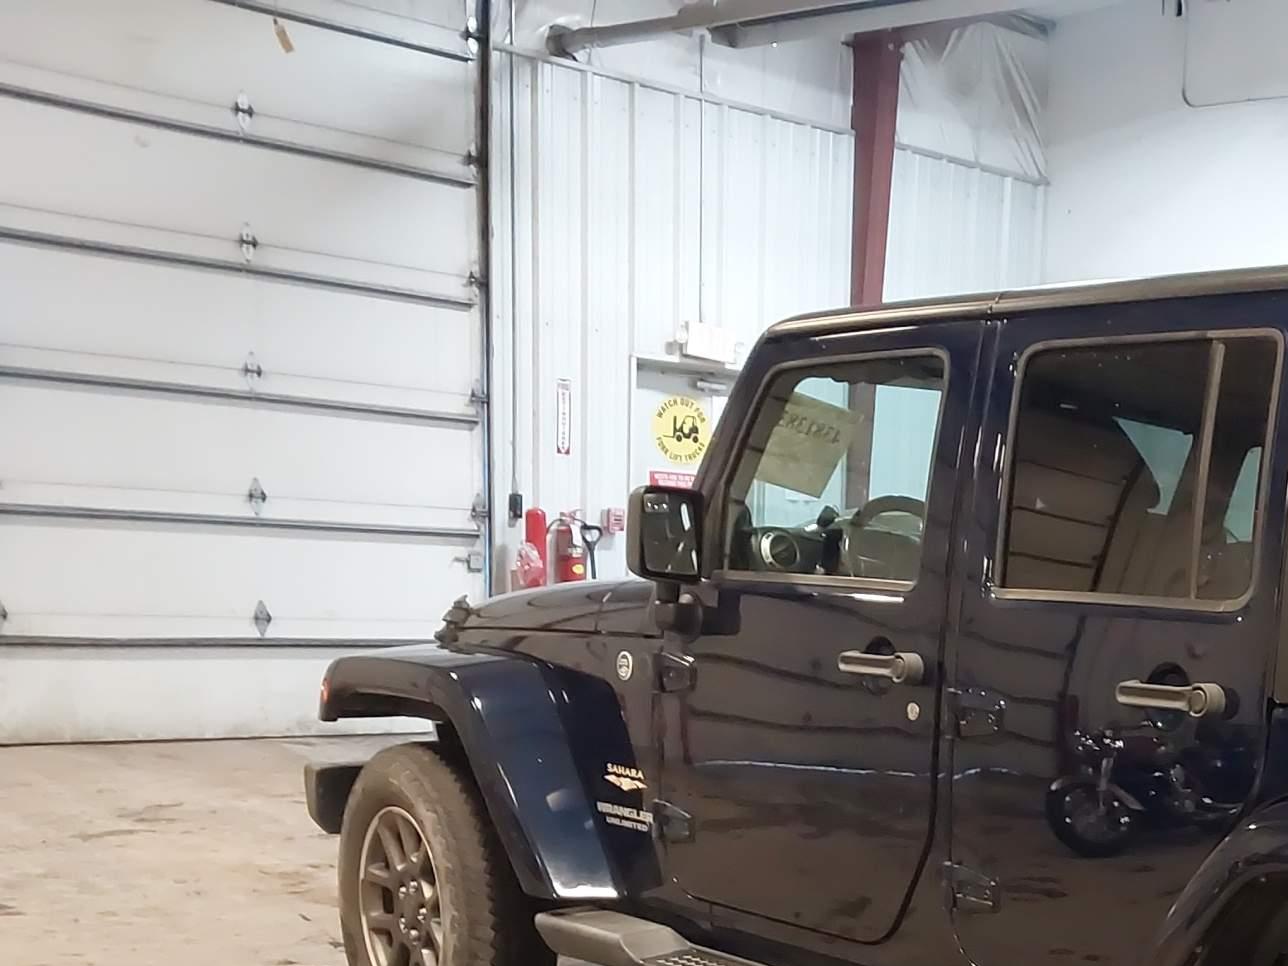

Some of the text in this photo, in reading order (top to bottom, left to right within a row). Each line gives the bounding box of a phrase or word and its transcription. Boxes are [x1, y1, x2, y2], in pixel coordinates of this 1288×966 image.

[656, 397, 706, 424] WATCH OUT FOR
[606, 763, 644, 779] SAHARA
[596, 801, 654, 825] WRANGLER
